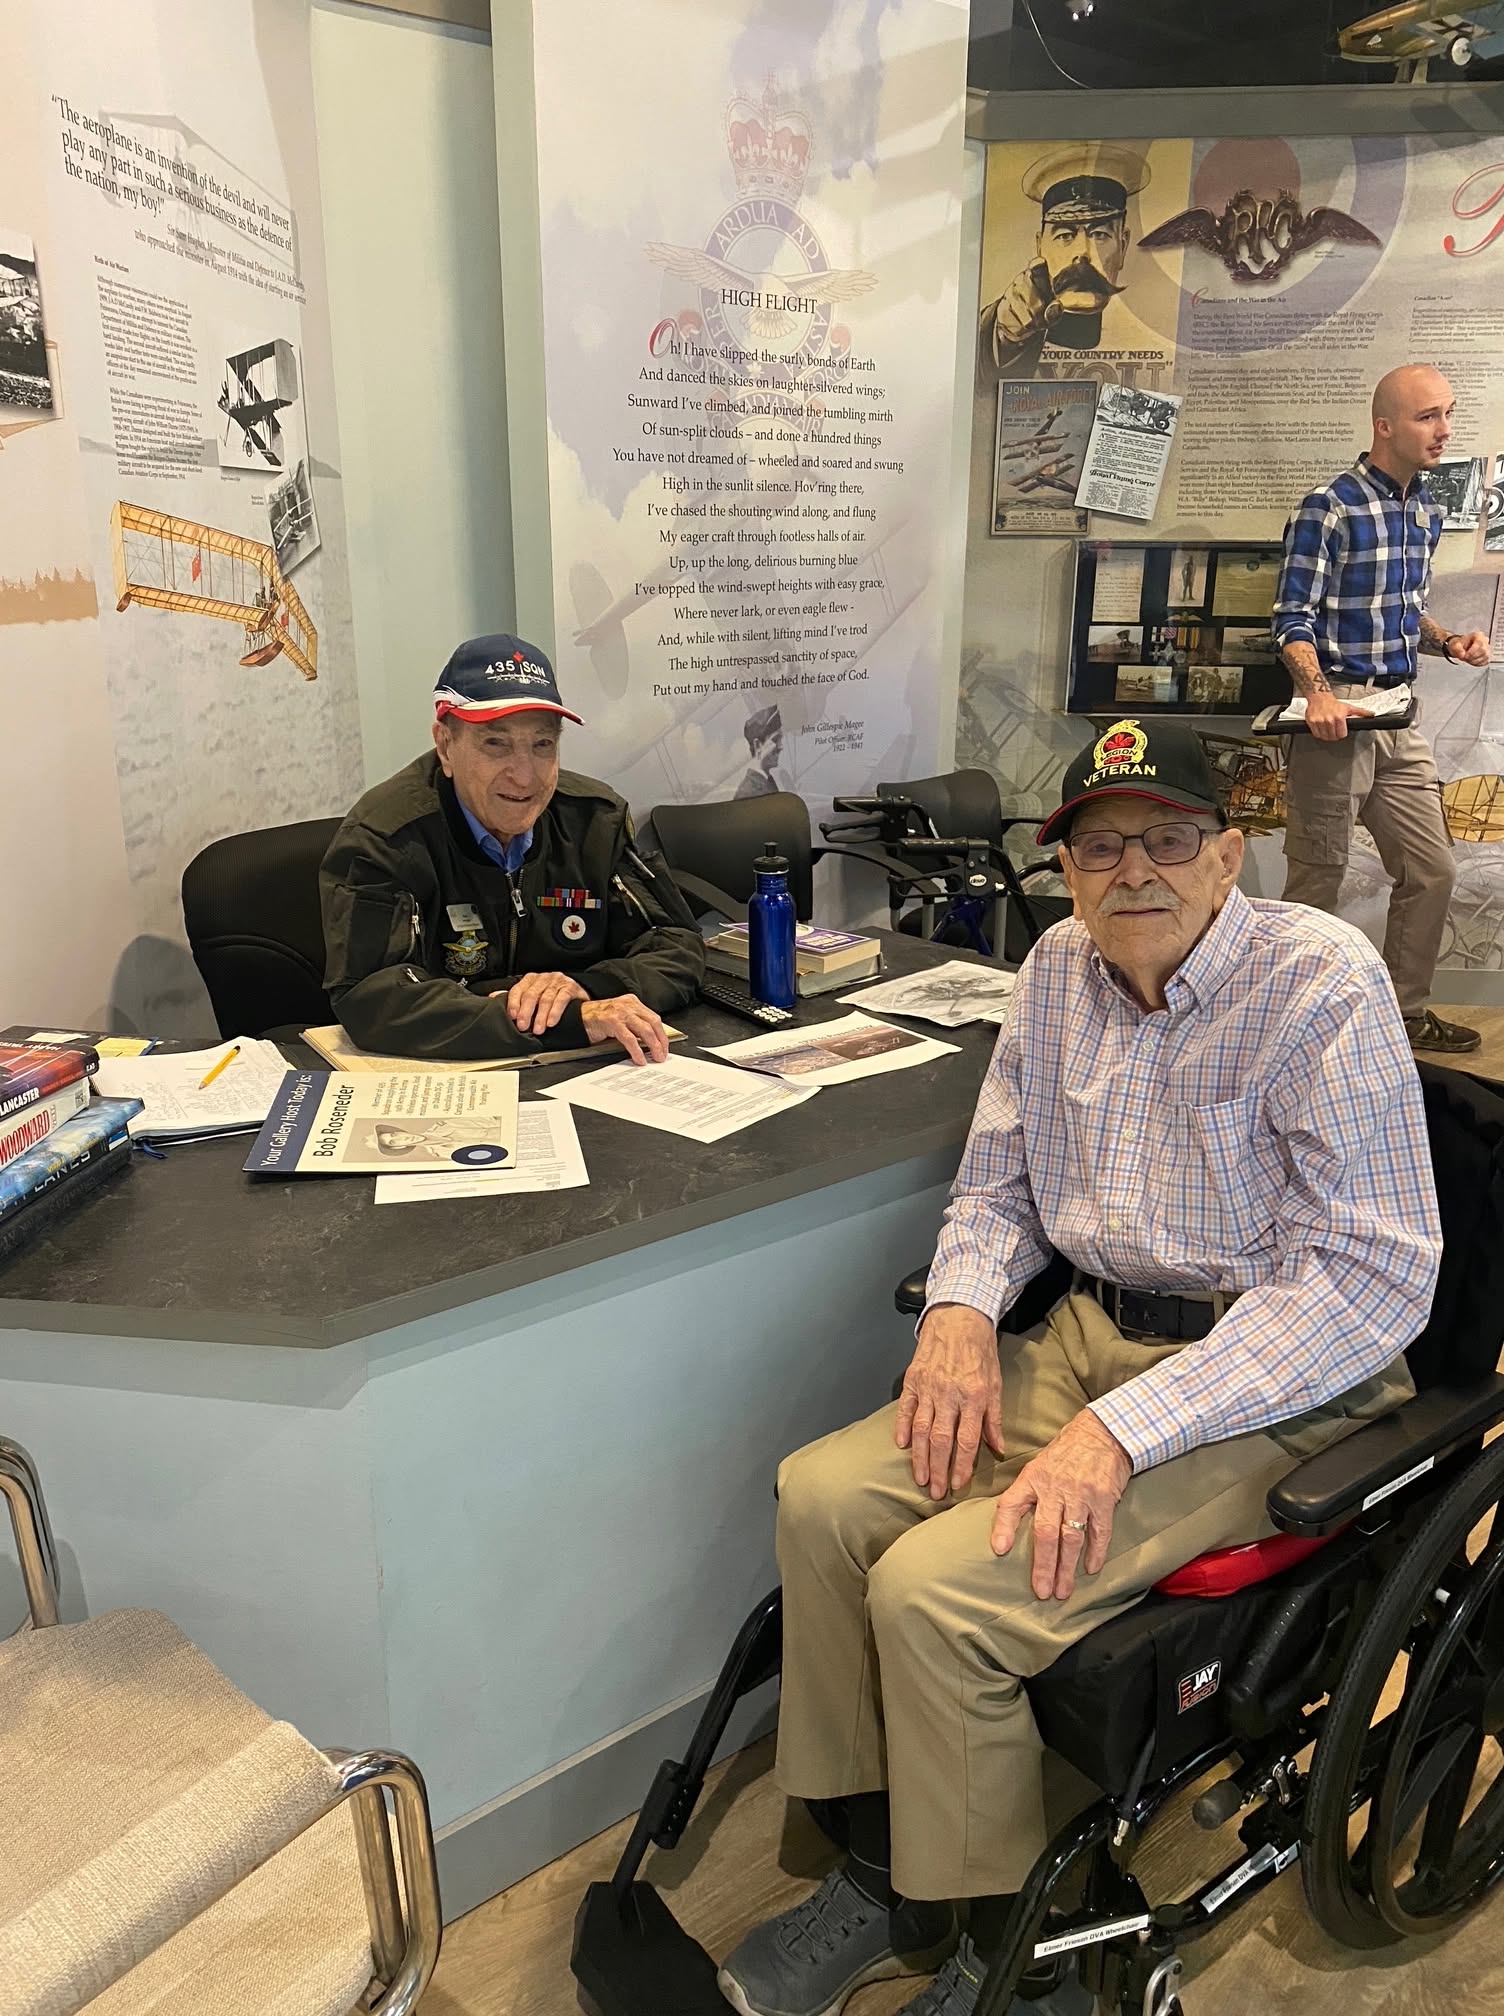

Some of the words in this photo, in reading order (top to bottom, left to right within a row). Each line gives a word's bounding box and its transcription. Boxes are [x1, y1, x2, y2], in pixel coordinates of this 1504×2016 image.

[65, 154, 82, 179] the
[85, 169, 121, 199] nation,
[123, 186, 138, 209] my
[83, 116, 132, 151] aeroplane
[134, 137, 142, 157] is
[145, 147, 156, 164] an
[158, 149, 198, 186] invention
[200, 173, 208, 190] of
[209, 176, 221, 196] the
[223, 184, 241, 207] devil
[242, 198, 256, 214] and
[257, 204, 271, 221] will
[272, 213, 289, 231] never
[62, 128, 85, 160] play
[89, 145, 107, 171] any
[111, 155, 131, 176] part
[133, 160, 144, 182] in
[145, 171, 166, 192] such
[168, 183, 173, 195] a
[174, 186, 204, 210] serious
[205, 196, 237, 226] business
[238, 217, 247, 230] as
[247, 217, 259, 236] the
[260, 224, 284, 248] defence
[285, 237, 292, 251] of
[715, 201, 777, 252] ARDUA
[792, 223, 819, 258] AD
[721, 288, 761, 308] HIGH
[765, 293, 818, 314] FLIGHT
[648, 317, 682, 359] Oh!
[684, 341, 688, 356] I
[690, 341, 717, 359] have
[719, 345, 761, 365] slipped
[761, 348, 777, 363] the
[779, 351, 806, 371] surly
[807, 352, 837, 369] bonds
[838, 353, 850, 370] of
[850, 357, 876, 371] Earth
[1074, 350, 1125, 360] COUNTRY
[1127, 350, 1165, 360] NEEDS
[639, 367, 664, 381] And
[666, 368, 706, 384] danced
[709, 370, 726, 386] the
[727, 372, 754, 388] skies
[755, 378, 769, 388] on
[772, 375, 853, 395] laughter-silvered
[855, 383, 886, 401] wings;
[1005, 385, 1030, 395] JOIN
[627, 393, 678, 409] Sunward
[682, 396, 702, 411] I've
[704, 398, 749, 415] climbed,
[751, 402, 771, 415] and
[772, 402, 804, 424] joined
[806, 403, 822, 418] the
[823, 406, 866, 424] tumbling
[868, 409, 893, 422] mirth
[662, 476, 690, 494] High
[693, 477, 703, 490] in
[706, 477, 723, 491] the
[724, 478, 754, 492] sunlit
[756, 479, 792, 492] silence.
[794, 480, 837, 497] Hov'ring
[839, 480, 864, 495] there,
[647, 503, 668, 516] I've
[670, 502, 707, 517] chased
[709, 503, 726, 517] the
[728, 503, 773, 521] shouting
[774, 505, 800, 517] wind
[801, 504, 831, 522] along,
[832, 505, 850, 518] and
[852, 505, 876, 522] flung
[659, 529, 678, 547] My
[680, 533, 709, 547] eager
[711, 529, 735, 543] craft
[737, 528, 777, 546] through
[779, 529, 815, 542] footless
[817, 528, 839, 542] halls
[840, 529, 851, 542] of
[852, 530, 866, 541] air.
[669, 555, 689, 573] Up,
[691, 559, 706, 572] up
[708, 554, 725, 568] the
[726, 555, 752, 572] long,
[754, 554, 797, 567] delirious
[799, 554, 837, 570] burning
[838, 553, 858, 566] blue
[635, 582, 656, 596] I've
[658, 581, 695, 599] topped
[698, 580, 715, 594] the
[717, 579, 776, 596] wind-swept
[778, 577, 813, 595] heights
[814, 577, 836, 590] with
[837, 580, 857, 593] easy
[859, 579, 885, 593] grace,
[657, 632, 683, 647] And,
[686, 631, 715, 644] while
[717, 629, 740, 643] with
[742, 629, 772, 644] silent,
[773, 627, 802, 643] lifting
[804, 624, 828, 638] mind
[830, 624, 848, 637] I've
[849, 623, 868, 635] trod
[484, 661, 515, 674] 435
[523, 661, 546, 678] SQN
[668, 656, 688, 670] The
[690, 655, 714, 672] high
[716, 651, 781, 669] untrespassed
[781, 649, 818, 665] sanctity
[819, 648, 829, 660] of
[830, 650, 858, 663] space,
[653, 684, 671, 697] Put
[673, 683, 691, 695] out
[693, 683, 710, 697] my
[712, 678, 738, 692] hand
[740, 676, 758, 690] and
[761, 673, 798, 688] touched
[801, 672, 816, 685] the
[817, 672, 836, 684] face
[836, 669, 848, 682] of
[848, 668, 870, 681] God.
[1083, 764, 1156, 788] VETERAN
[0, 1087, 40, 1117] LANCASTER
[287, 1083, 313, 1104] Today
[280, 1104, 302, 1121] Host
[321, 1085, 356, 1134] Roseneder
[0, 1110, 50, 1165] WOODWARD
[269, 1122, 298, 1147] Gallery
[260, 1147, 283, 1166] Your
[313, 1137, 338, 1157] Bob
[1193, 1663, 1218, 1692] JAY
[1089, 1931, 1104, 1941] DVA
